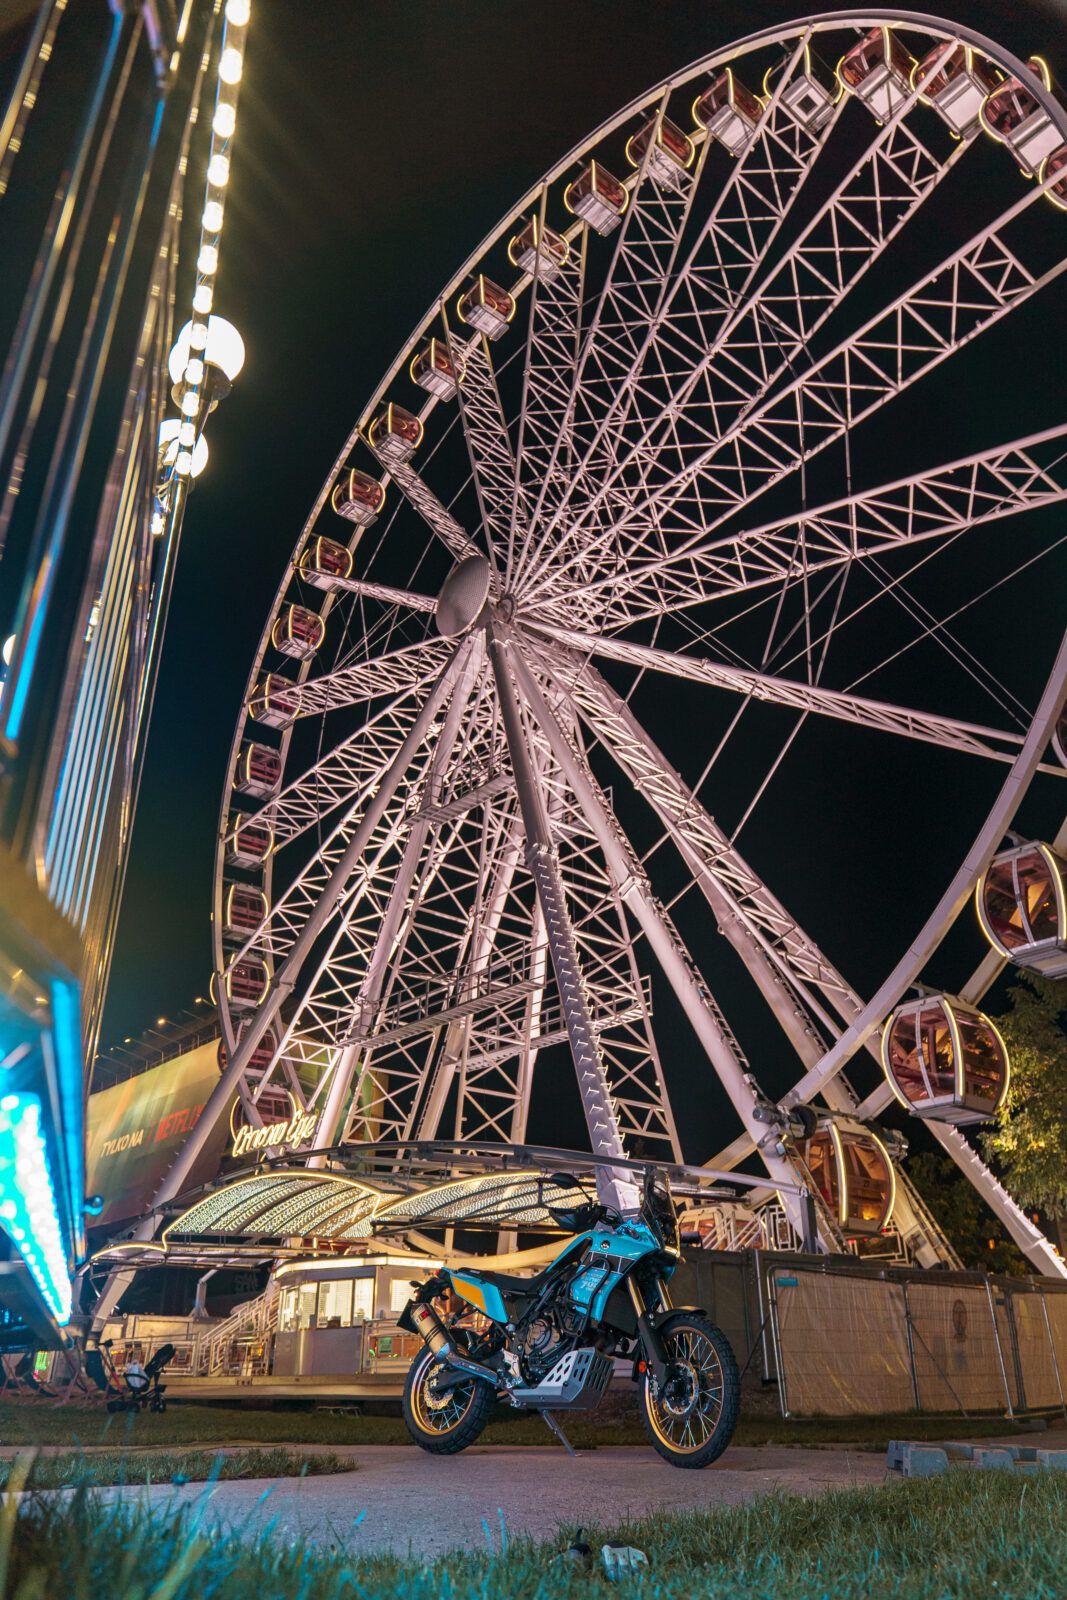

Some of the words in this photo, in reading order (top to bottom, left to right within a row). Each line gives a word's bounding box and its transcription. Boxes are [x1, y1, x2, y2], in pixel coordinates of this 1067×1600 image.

[102, 1135, 129, 1156] TYLKO
[127, 1129, 144, 1147] NA
[285, 1109, 317, 1149] Eye
